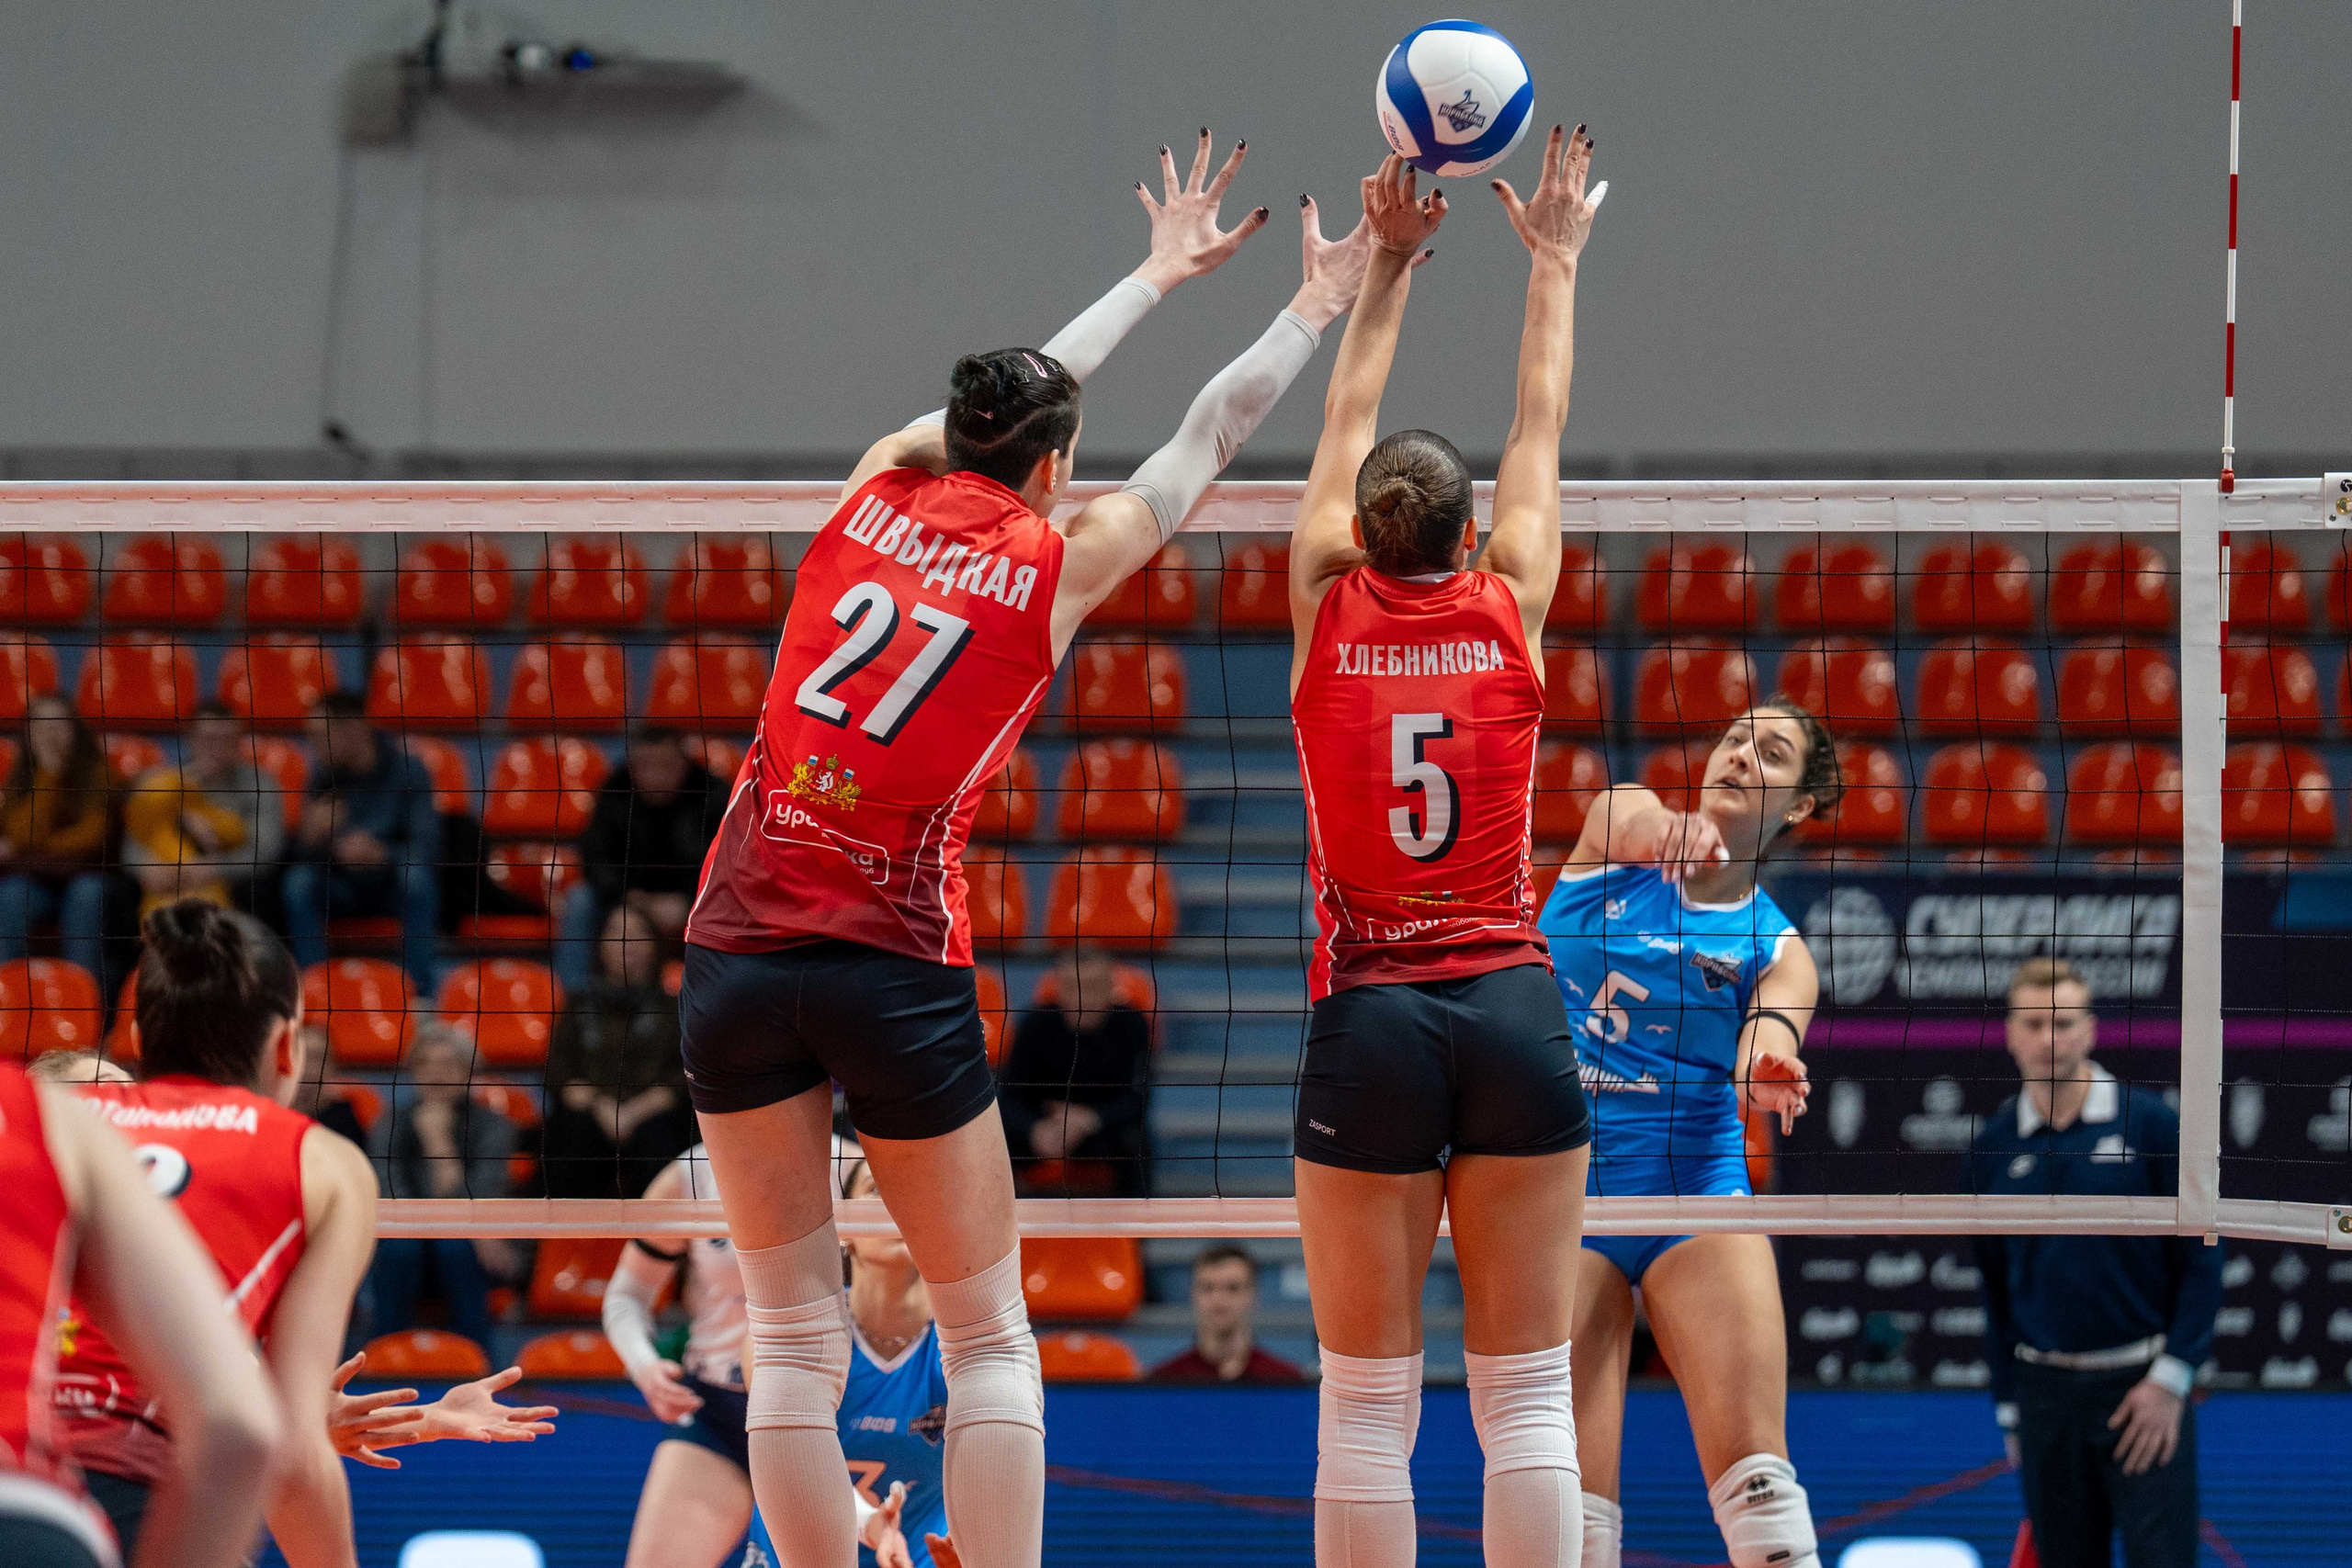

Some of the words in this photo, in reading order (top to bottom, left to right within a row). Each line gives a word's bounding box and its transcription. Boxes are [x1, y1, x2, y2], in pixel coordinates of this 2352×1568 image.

[842, 494, 1037, 612] ШВЫДКАЯ
[795, 581, 974, 747] 27
[1336, 639, 1505, 676] ХЛЕБНИКОВА
[1388, 713, 1461, 863] 5
[1585, 969, 1650, 1043] 5
[1308, 1118, 1337, 1137] ZASPORT
